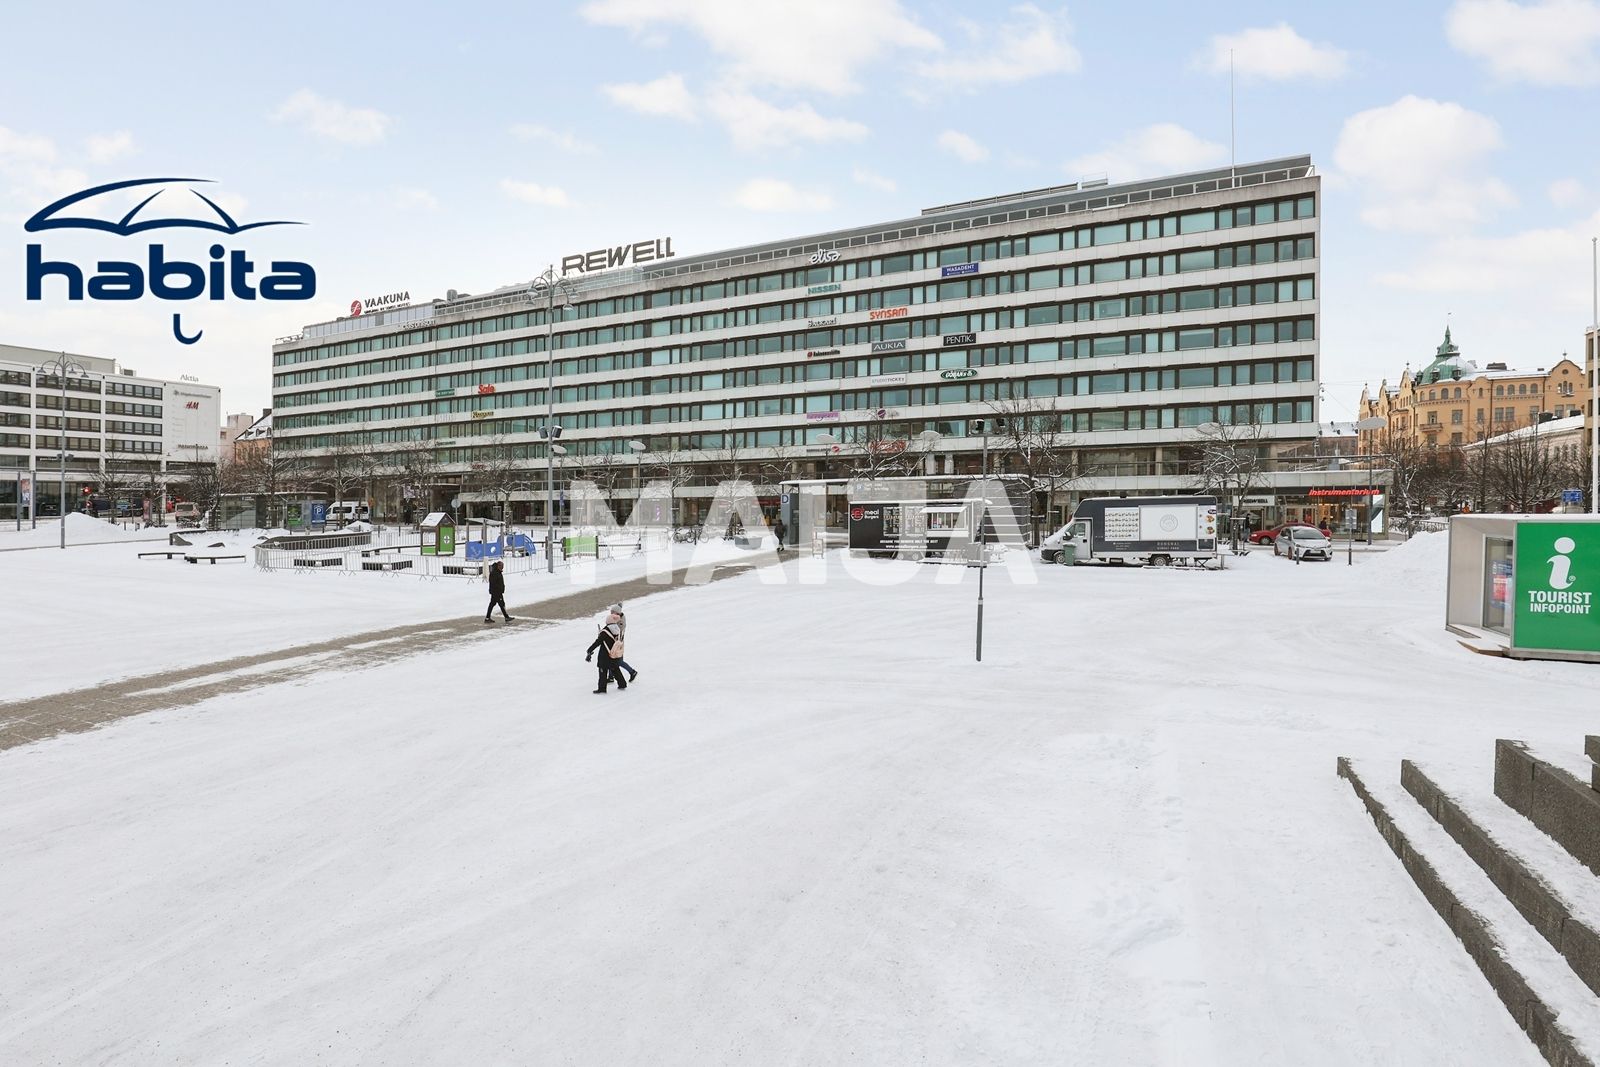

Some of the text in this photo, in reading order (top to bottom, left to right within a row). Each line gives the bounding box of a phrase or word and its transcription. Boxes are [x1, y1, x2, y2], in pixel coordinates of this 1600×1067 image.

[562, 236, 675, 276] REWELL
[808, 249, 840, 264] elisa
[808, 284, 841, 295] NISSEN
[364, 291, 410, 308] VAAKUNA
[870, 307, 907, 320] SYNSAM
[873, 342, 904, 351] AUKIA
[180, 374, 199, 382] Aktia
[478, 384, 495, 394] Sale
[1528, 591, 1592, 604] TOURIST
[1530, 603, 1591, 614] INFOPOINT
